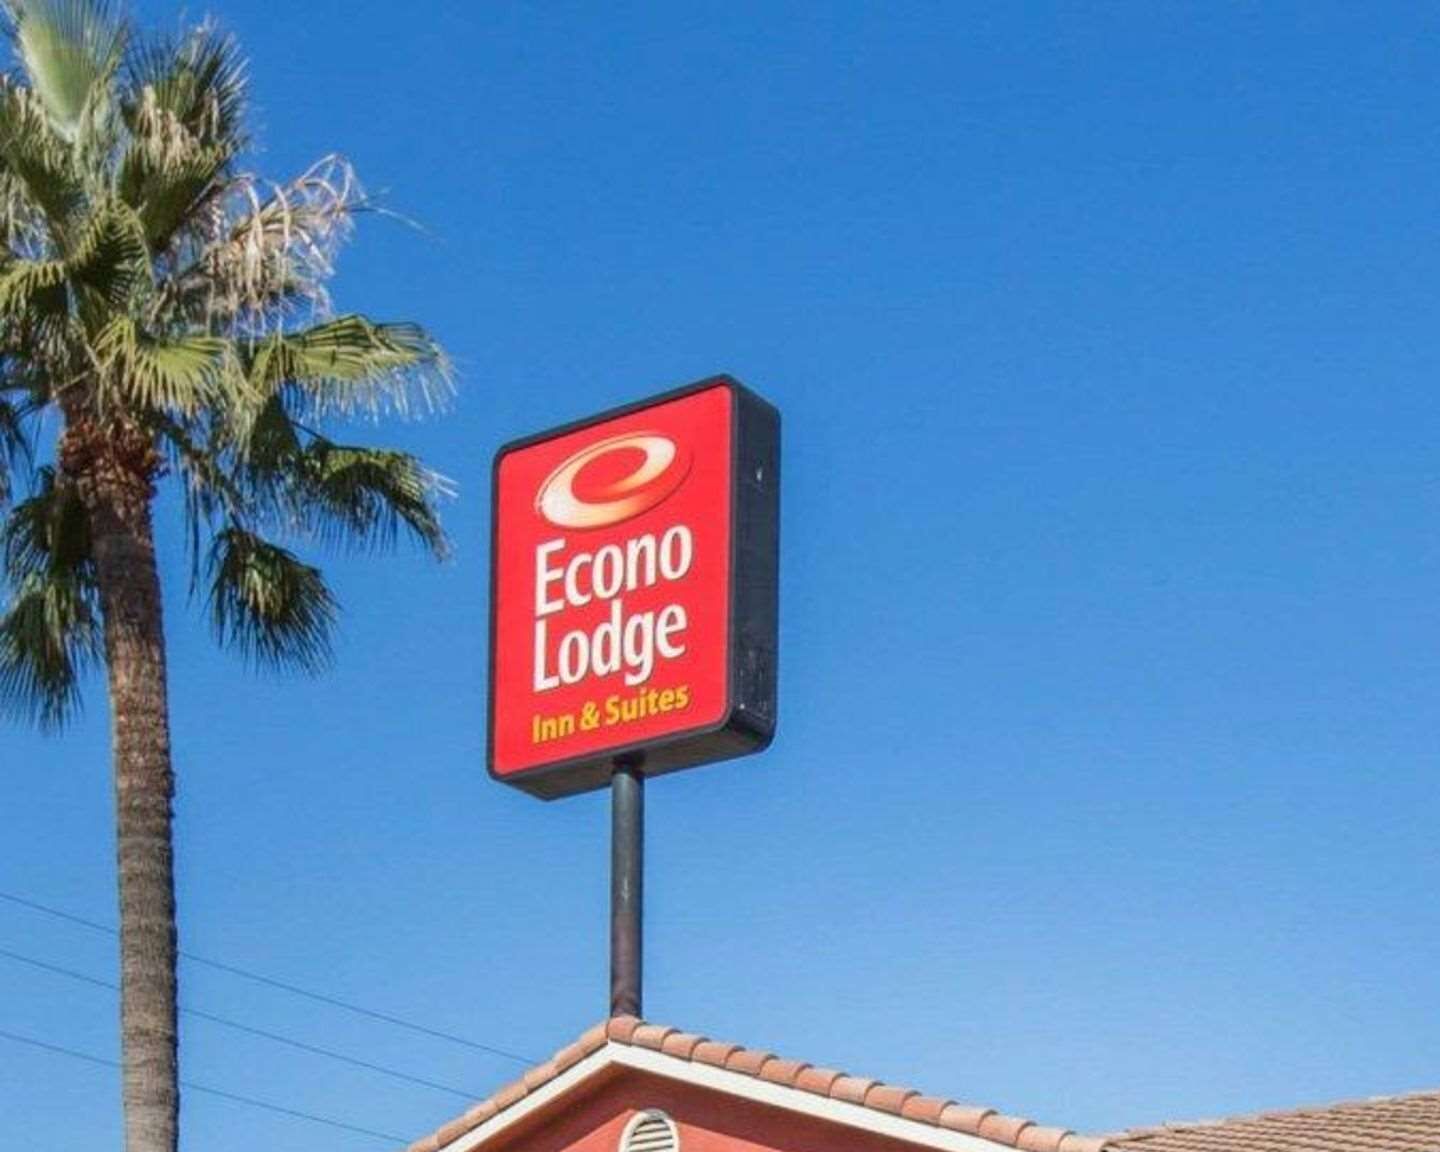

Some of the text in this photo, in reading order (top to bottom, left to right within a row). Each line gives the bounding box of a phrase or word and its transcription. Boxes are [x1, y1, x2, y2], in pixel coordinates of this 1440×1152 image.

[535, 525, 693, 618] Econo
[533, 599, 688, 693] Lodge
[532, 685, 689, 744] Inn & Suites
